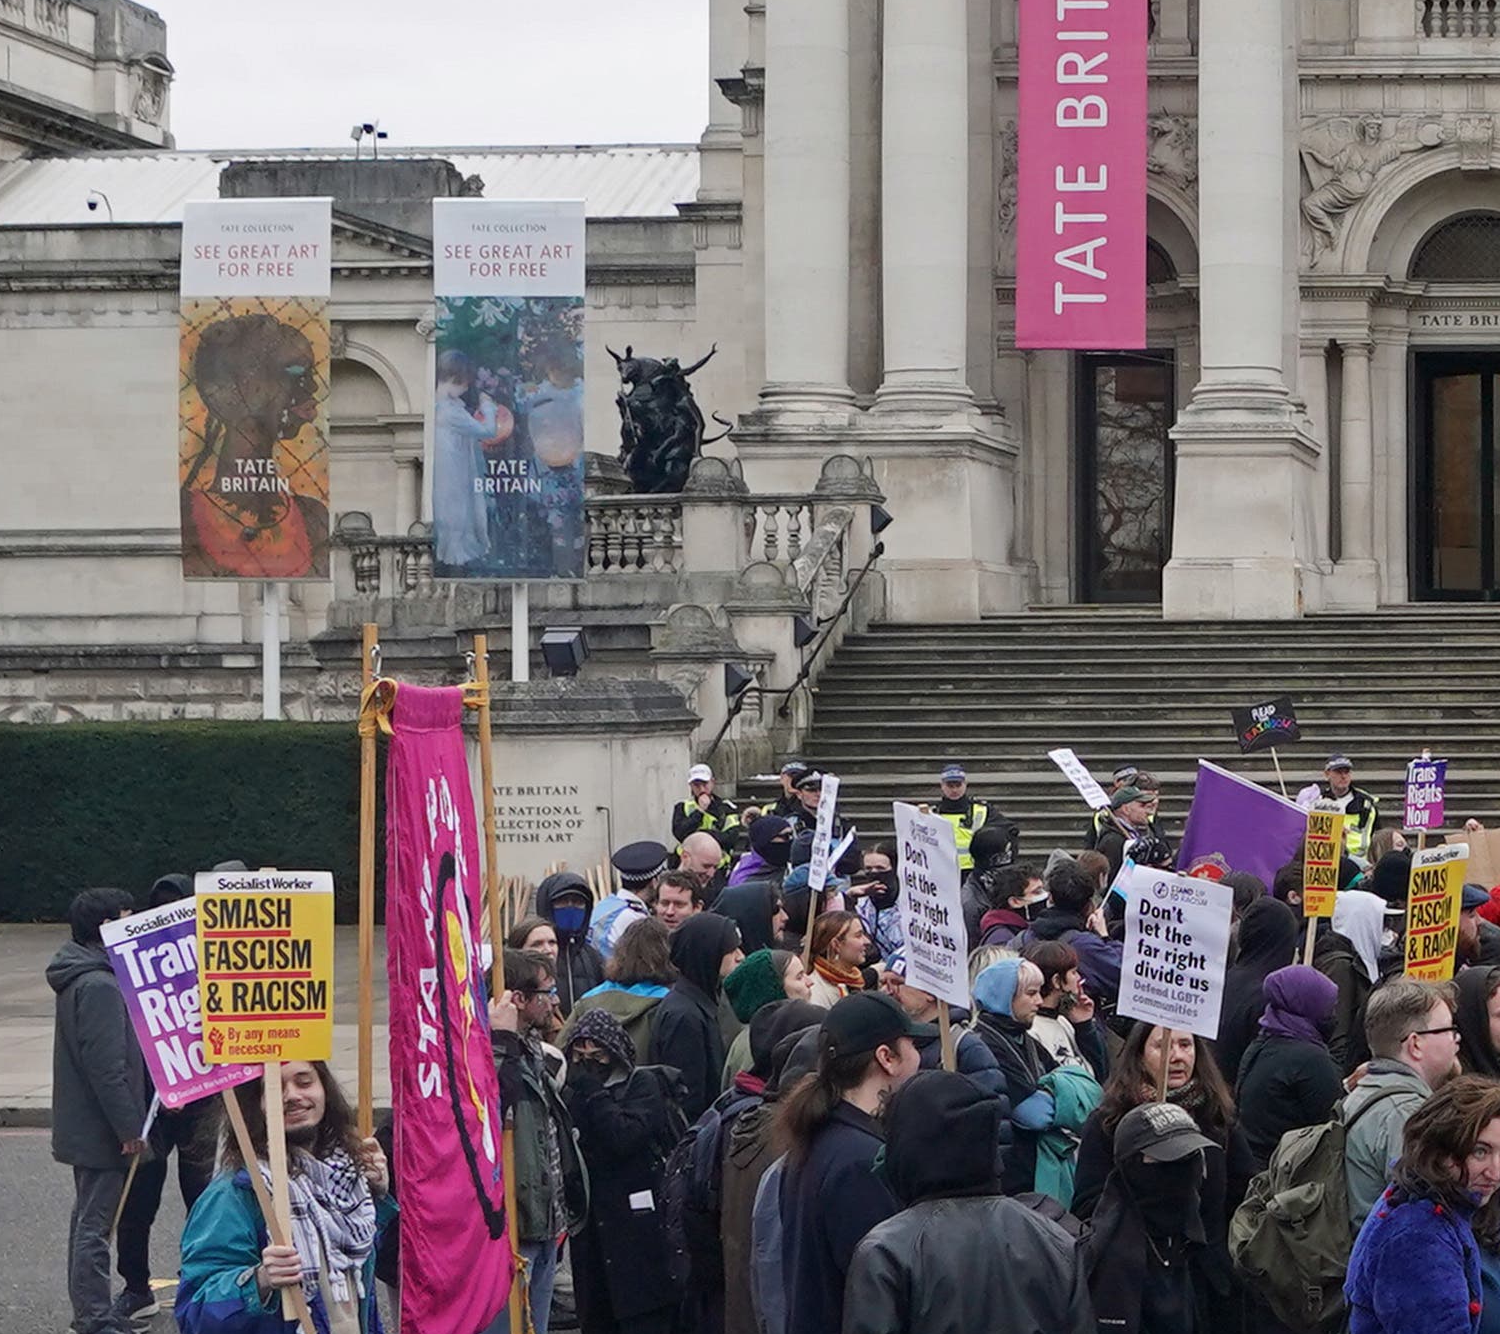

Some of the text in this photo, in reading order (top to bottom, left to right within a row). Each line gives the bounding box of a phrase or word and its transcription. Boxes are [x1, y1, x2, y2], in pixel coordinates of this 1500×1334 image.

[220, 224, 295, 233] TATE COLLECTION
[470, 224, 547, 233] TATE COLLECTION
[1054, 164, 1108, 314] TATE
[193, 244, 320, 260] SEE GREAT ART
[444, 245, 574, 260] SEE GREAT ART
[217, 262, 295, 277] FOR FREE
[469, 262, 548, 277] FOR FREE
[1418, 312, 1464, 327] TATE
[235, 459, 276, 475] TATE
[487, 459, 528, 475] TATE
[220, 477, 290, 493] BRITAIN
[473, 477, 543, 494] BRITAIN
[1251, 704, 1277, 721] READ
[1408, 765, 1438, 784] Trans
[493, 786, 578, 796] ATE BRITAIN
[1406, 784, 1443, 808] Rights
[509, 805, 582, 816] NATIONAL
[1406, 806, 1430, 826] Now
[566, 819, 585, 829] OF
[496, 832, 574, 843] RITISH ART
[904, 867, 938, 898] let the
[202, 898, 292, 929] SMASH
[908, 892, 950, 927] far right
[1139, 898, 1184, 924] Don't
[907, 921, 957, 951] divide us
[1139, 919, 1193, 947] let the
[203, 938, 312, 971] FASCISM
[1137, 938, 1207, 971] far right
[1408, 937, 1419, 961] &
[113, 934, 197, 989] Tran
[1134, 960, 1210, 993] divide us
[206, 980, 327, 1013] & RACISM
[1133, 979, 1206, 1005] Defend LGBT+
[1132, 994, 1199, 1018] communities
[228, 1028, 301, 1043] By any means
[228, 1043, 283, 1056] necessary
